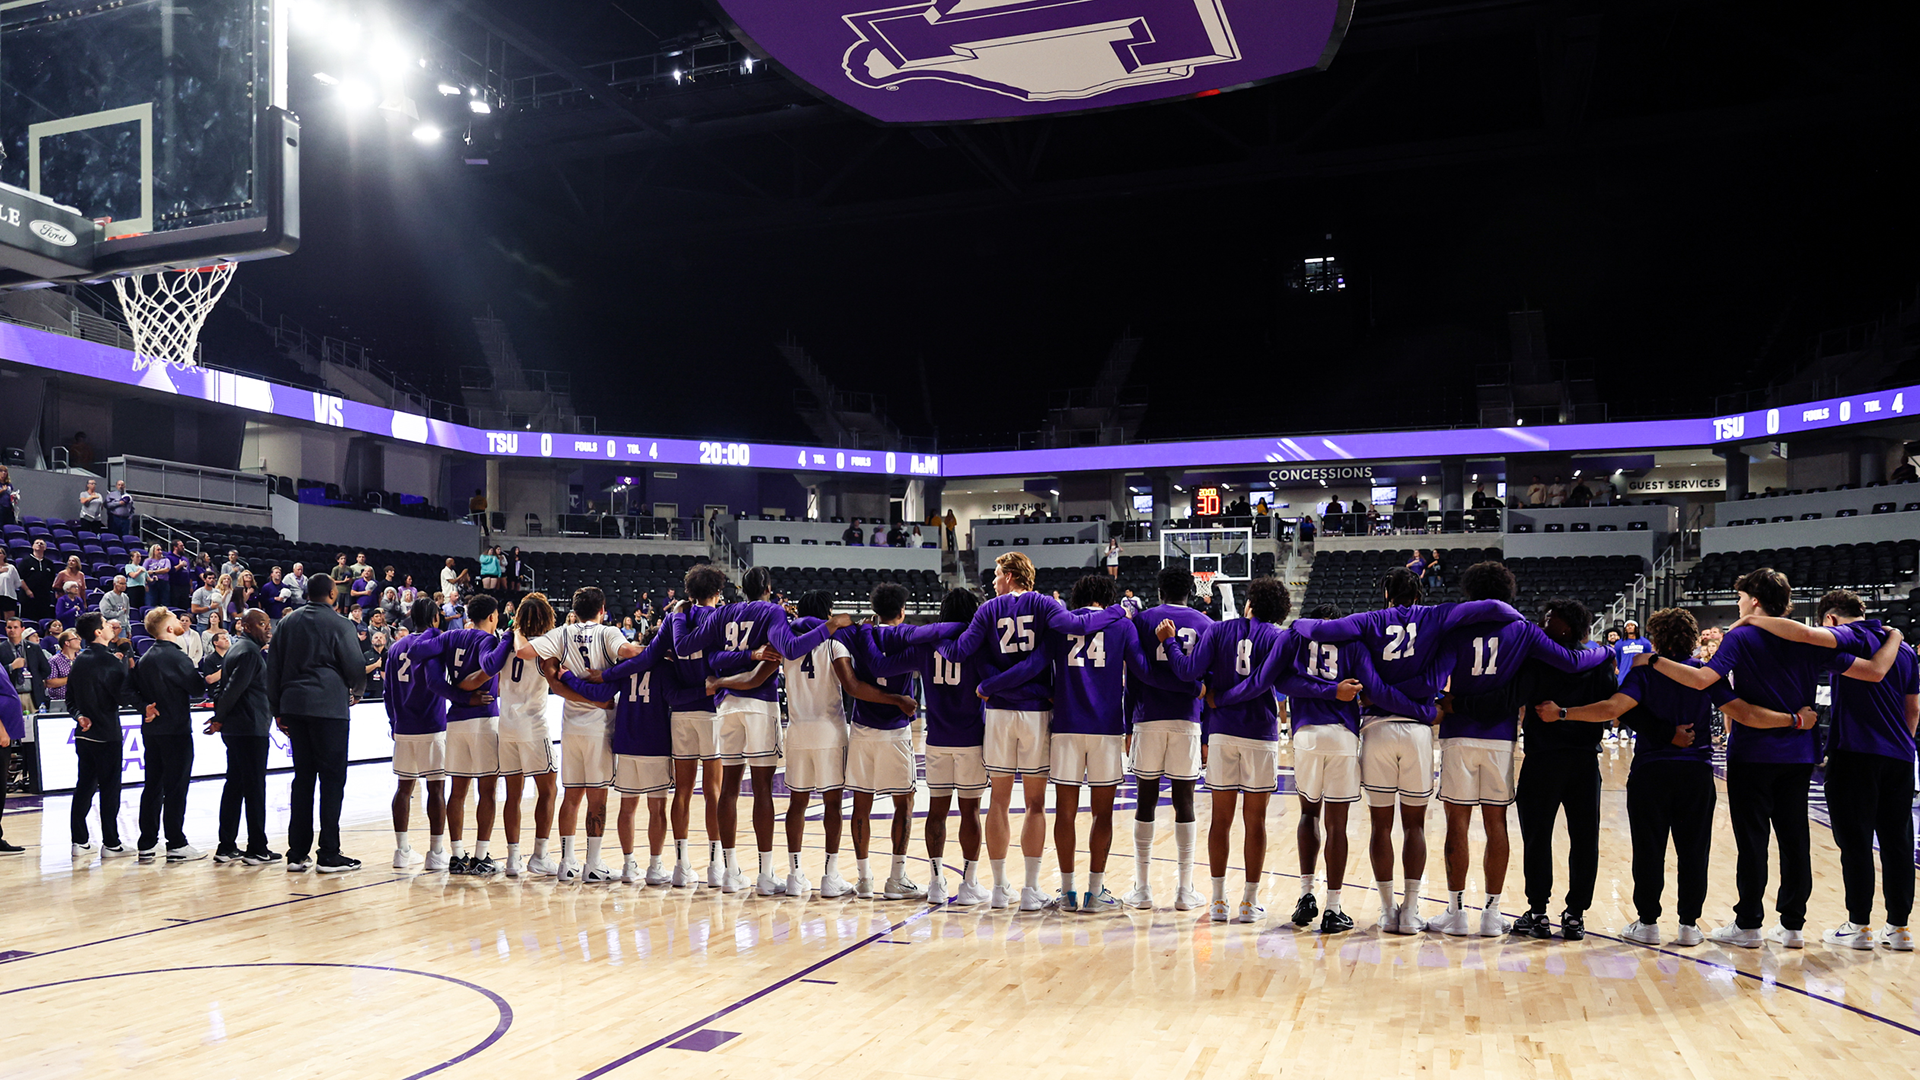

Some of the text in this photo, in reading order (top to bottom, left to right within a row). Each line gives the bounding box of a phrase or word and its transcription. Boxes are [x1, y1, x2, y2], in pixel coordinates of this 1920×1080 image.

[40, 224, 68, 243] Ford
[312, 392, 344, 428] VS
[1713, 415, 1745, 440] TSU
[1766, 408, 1780, 435] 0
[1803, 408, 1829, 422] FOULS
[1839, 401, 1851, 422] 0
[1891, 393, 1904, 413] 4
[486, 432, 518, 453] TSU
[540, 433, 552, 457] 0
[575, 441, 598, 453] FOULS
[606, 439, 616, 458] 0
[649, 442, 658, 459] 4
[699, 442, 750, 466] 20:00
[798, 450, 807, 467] 4
[836, 452, 845, 469] 0
[851, 456, 871, 467] FOULS
[885, 452, 896, 474] 0
[910, 455, 939, 475] A&M
[1268, 466, 1373, 481] CONCESSIONS
[1628, 479, 1721, 490] GUEST SERVICES
[992, 503, 1019, 512] SPIRIT
[1197, 496, 1220, 515] 30
[724, 620, 755, 651] 97
[997, 614, 1036, 654] 25
[1066, 631, 1106, 668] 24
[1382, 622, 1418, 661] 21
[397, 653, 411, 682] 2
[511, 656, 524, 682] 0
[800, 649, 815, 679] 4
[932, 650, 962, 686] 10
[1235, 638, 1253, 676] 8
[1306, 641, 1339, 680] 13
[1471, 636, 1499, 676] 11
[628, 671, 652, 703] 14
